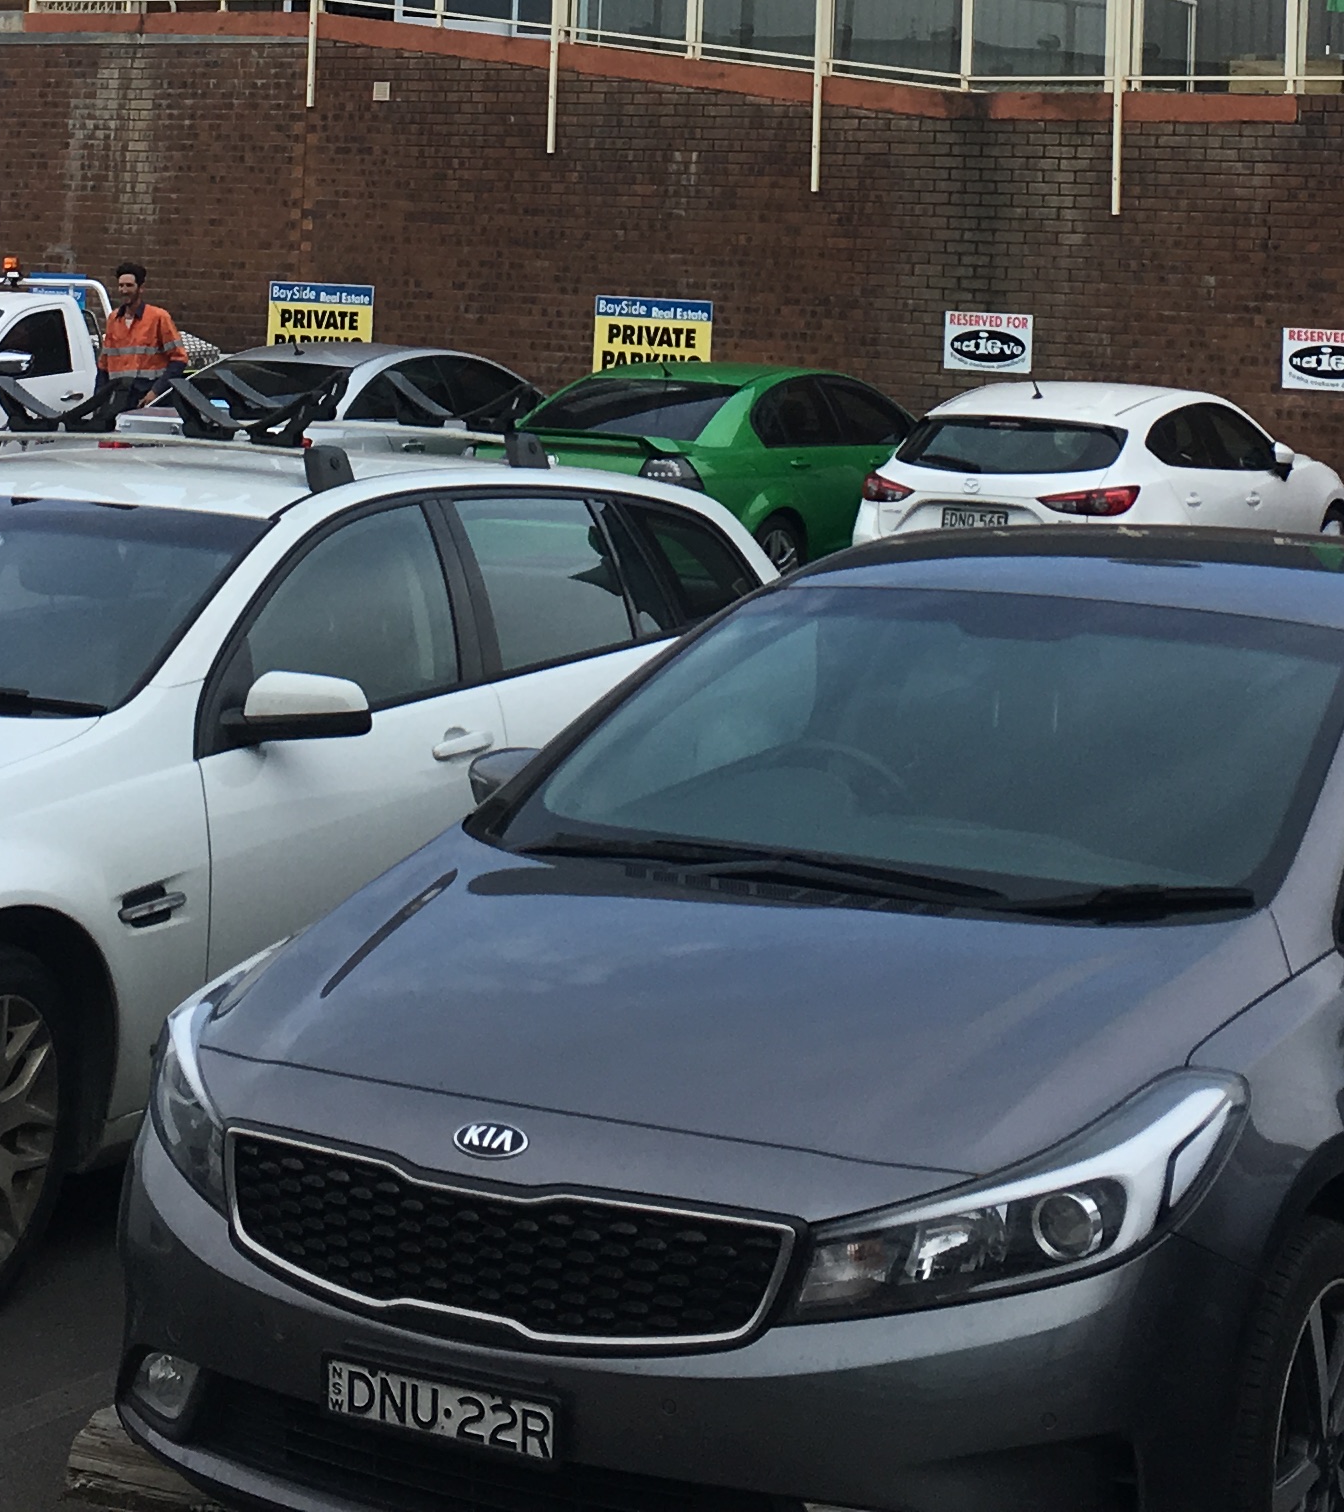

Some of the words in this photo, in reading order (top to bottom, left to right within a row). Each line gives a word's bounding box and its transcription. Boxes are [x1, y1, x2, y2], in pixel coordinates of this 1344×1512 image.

[272, 286, 316, 301] BaySide
[320, 291, 341, 303] Real
[341, 292, 370, 304] Estate
[280, 308, 359, 331] PRIVATE
[599, 299, 647, 316] BaySide
[651, 307, 674, 319] Real
[676, 308, 709, 321] Estate
[949, 313, 1003, 328] RESERVED
[1006, 316, 1029, 329] FOR
[607, 323, 697, 349] PRIVATE
[601, 350, 702, 370] PARK
[462, 1125, 513, 1152] KIA
